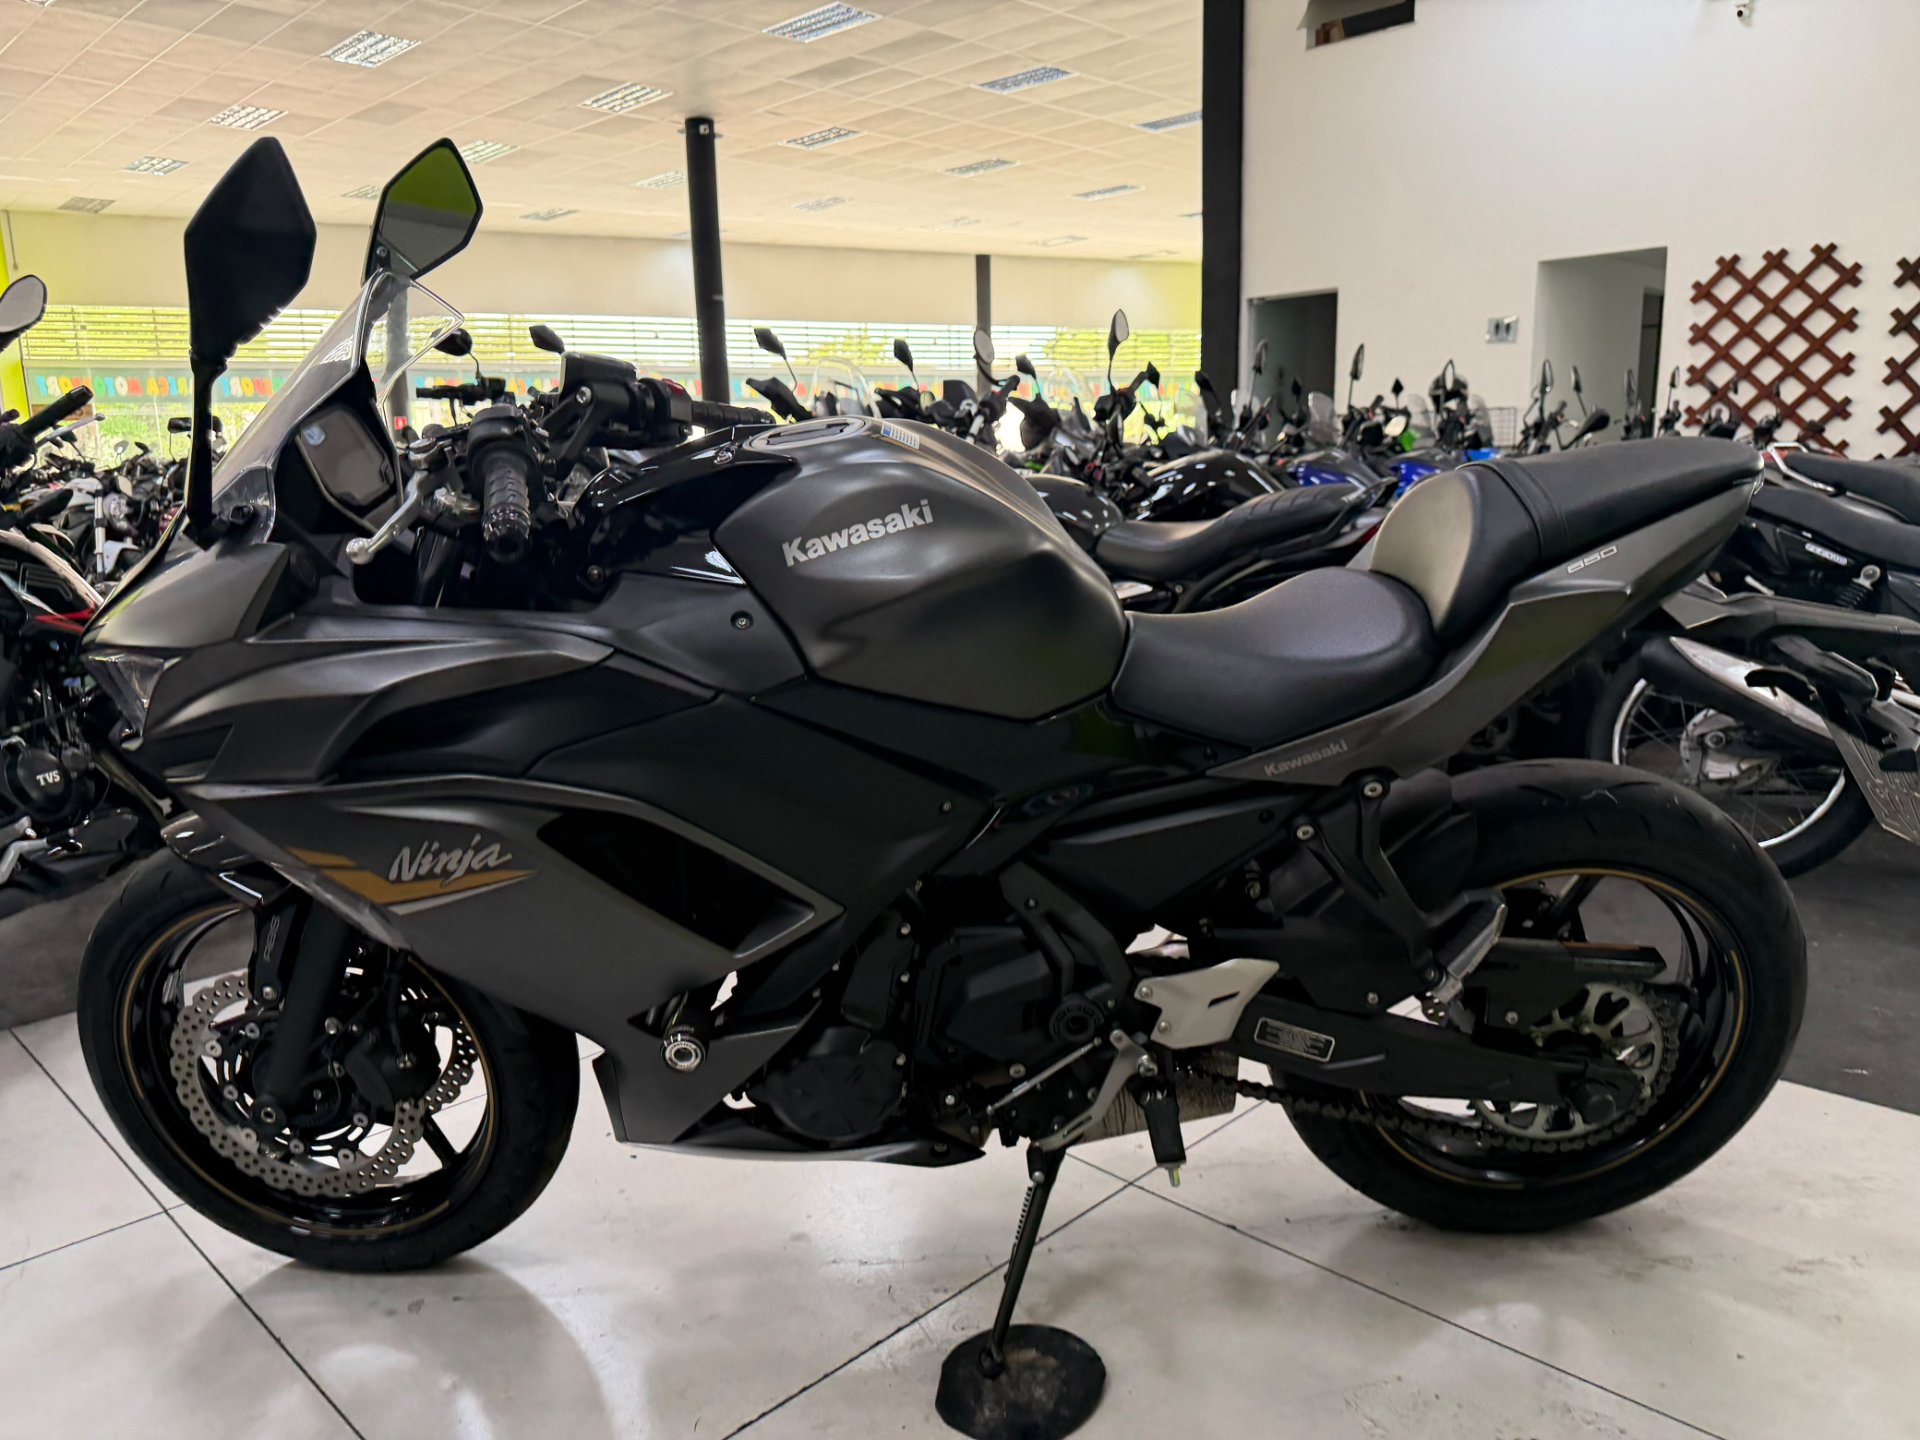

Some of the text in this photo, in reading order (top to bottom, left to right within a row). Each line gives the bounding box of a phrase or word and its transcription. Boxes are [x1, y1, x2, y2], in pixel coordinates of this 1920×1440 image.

[782, 499, 934, 567] Kawasaki
[1567, 545, 1617, 574] 650
[1264, 739, 1349, 777] Kawasaki
[36, 769, 61, 787] TVS
[388, 833, 513, 888] Ninja
